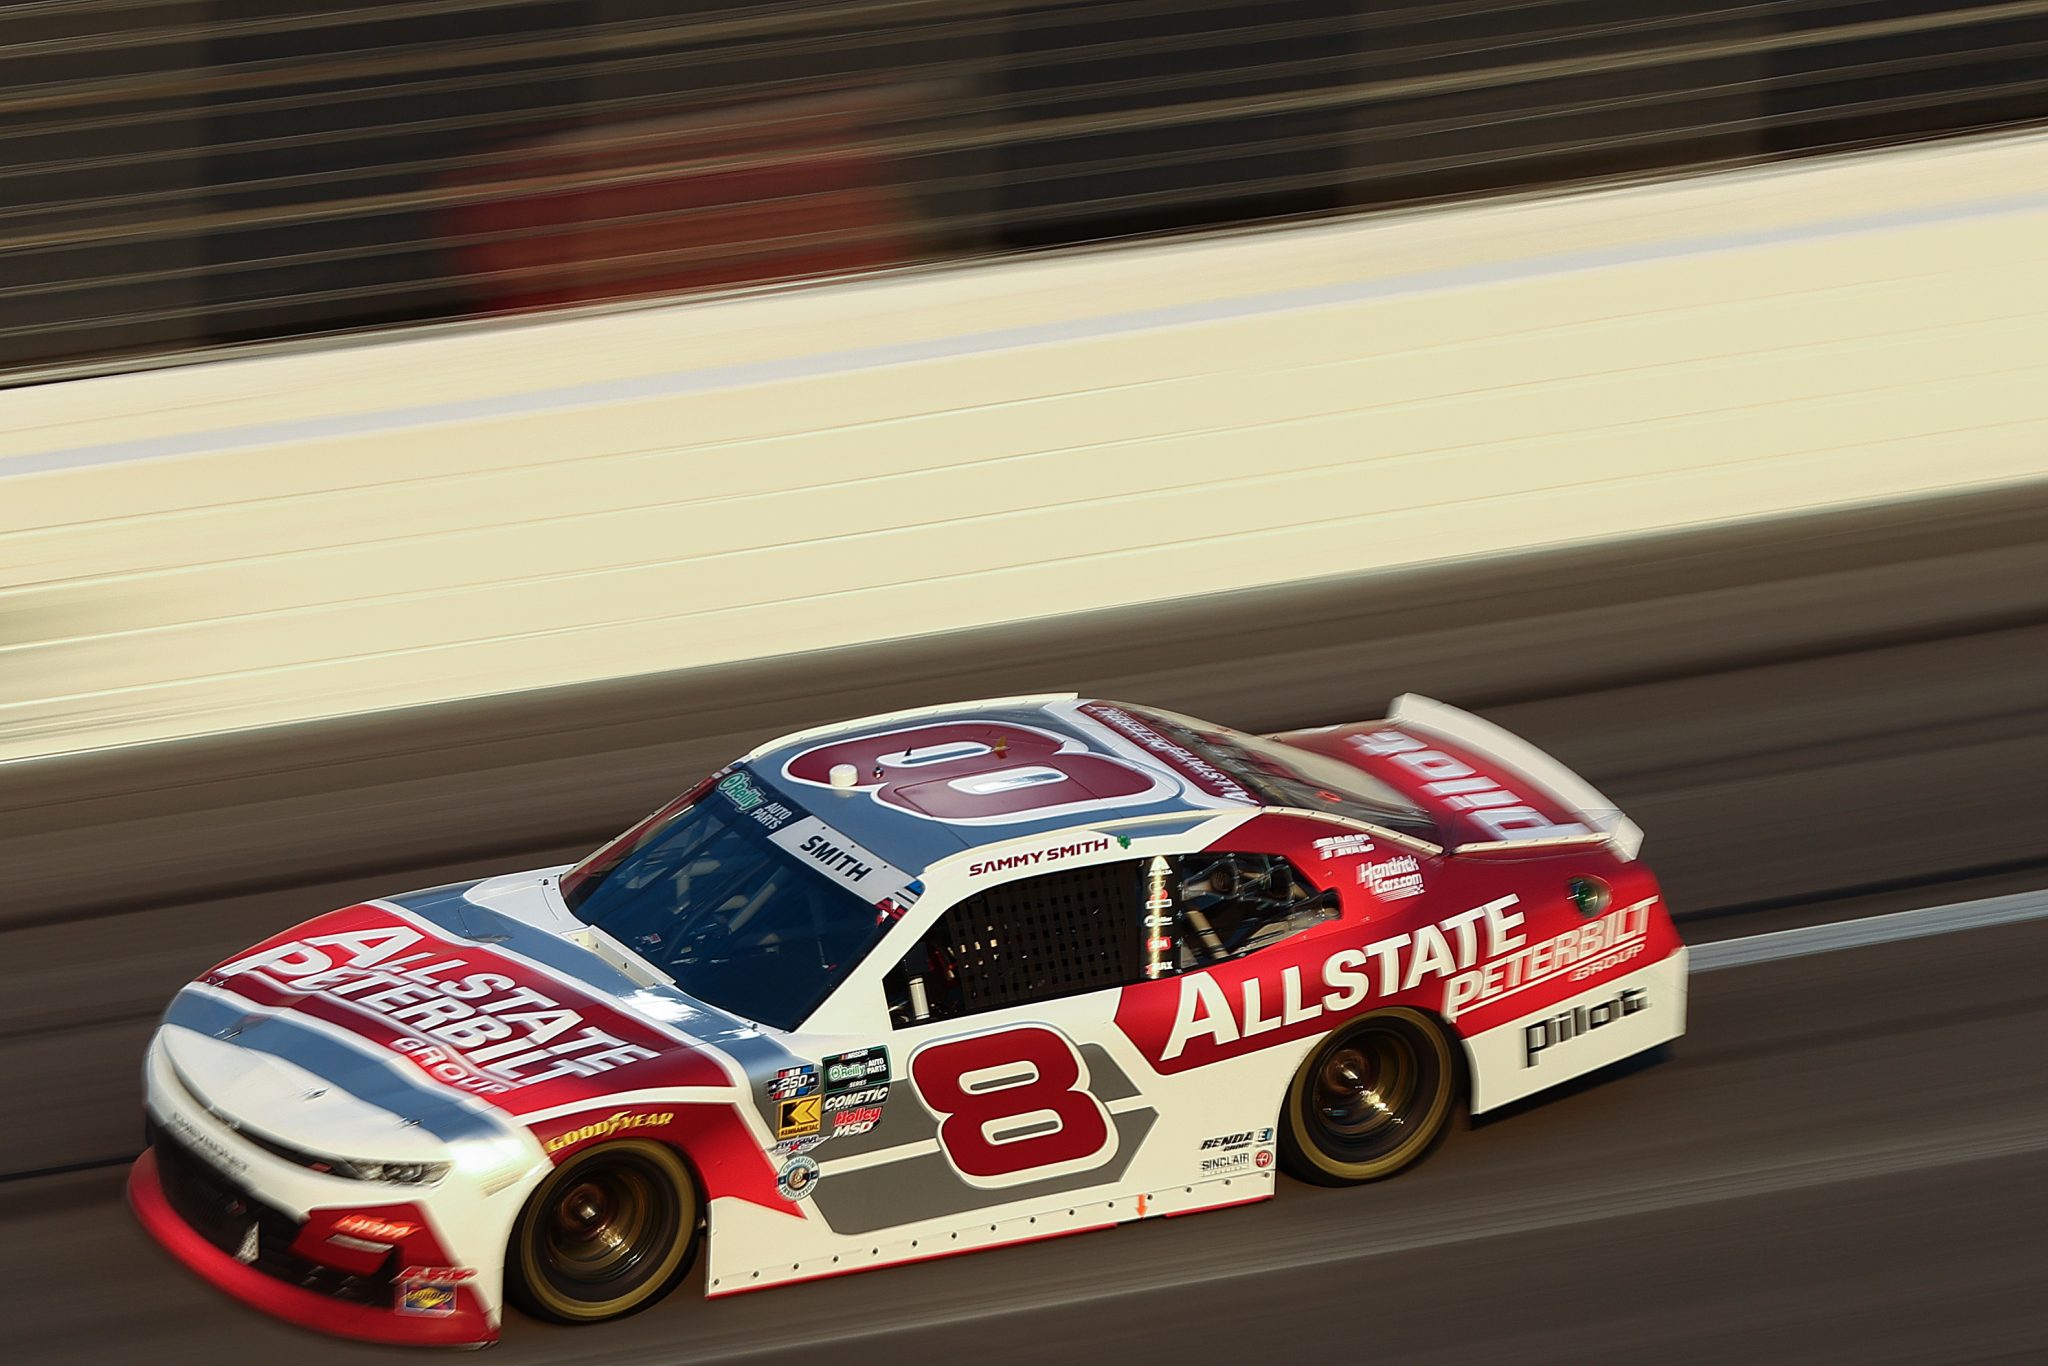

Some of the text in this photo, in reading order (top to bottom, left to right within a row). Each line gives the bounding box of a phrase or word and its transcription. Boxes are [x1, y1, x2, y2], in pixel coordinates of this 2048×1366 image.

[785, 720, 1158, 820] 8
[750, 807, 783, 830] PARTS
[764, 802, 793, 820] AUTO
[799, 835, 873, 882] SMITH
[969, 838, 1109, 877] SAMMY SMITH
[1356, 855, 1420, 888] Hendrick
[1440, 895, 1659, 1024] PETERBILT
[1160, 893, 1527, 1061] ALLSTATE
[212, 941, 590, 1087] PETERBILT
[301, 926, 661, 1077] ALLSTATE
[1521, 987, 1650, 1069] pilot
[390, 1038, 510, 1094] GROUP
[829, 1063, 866, 1080] O'Reilly
[866, 1064, 887, 1075] PARTS
[868, 1058, 885, 1067] AUTO
[778, 1074, 809, 1092] 250
[824, 1087, 889, 1110] COMETIC
[833, 1106, 883, 1127] Holley
[910, 1026, 1108, 1177] 8
[548, 1111, 674, 1151] GOODYEAR
[831, 1121, 875, 1139] MSD
[1200, 1131, 1254, 1150] RENDA
[1201, 1152, 1249, 1171] SINCLAIR
